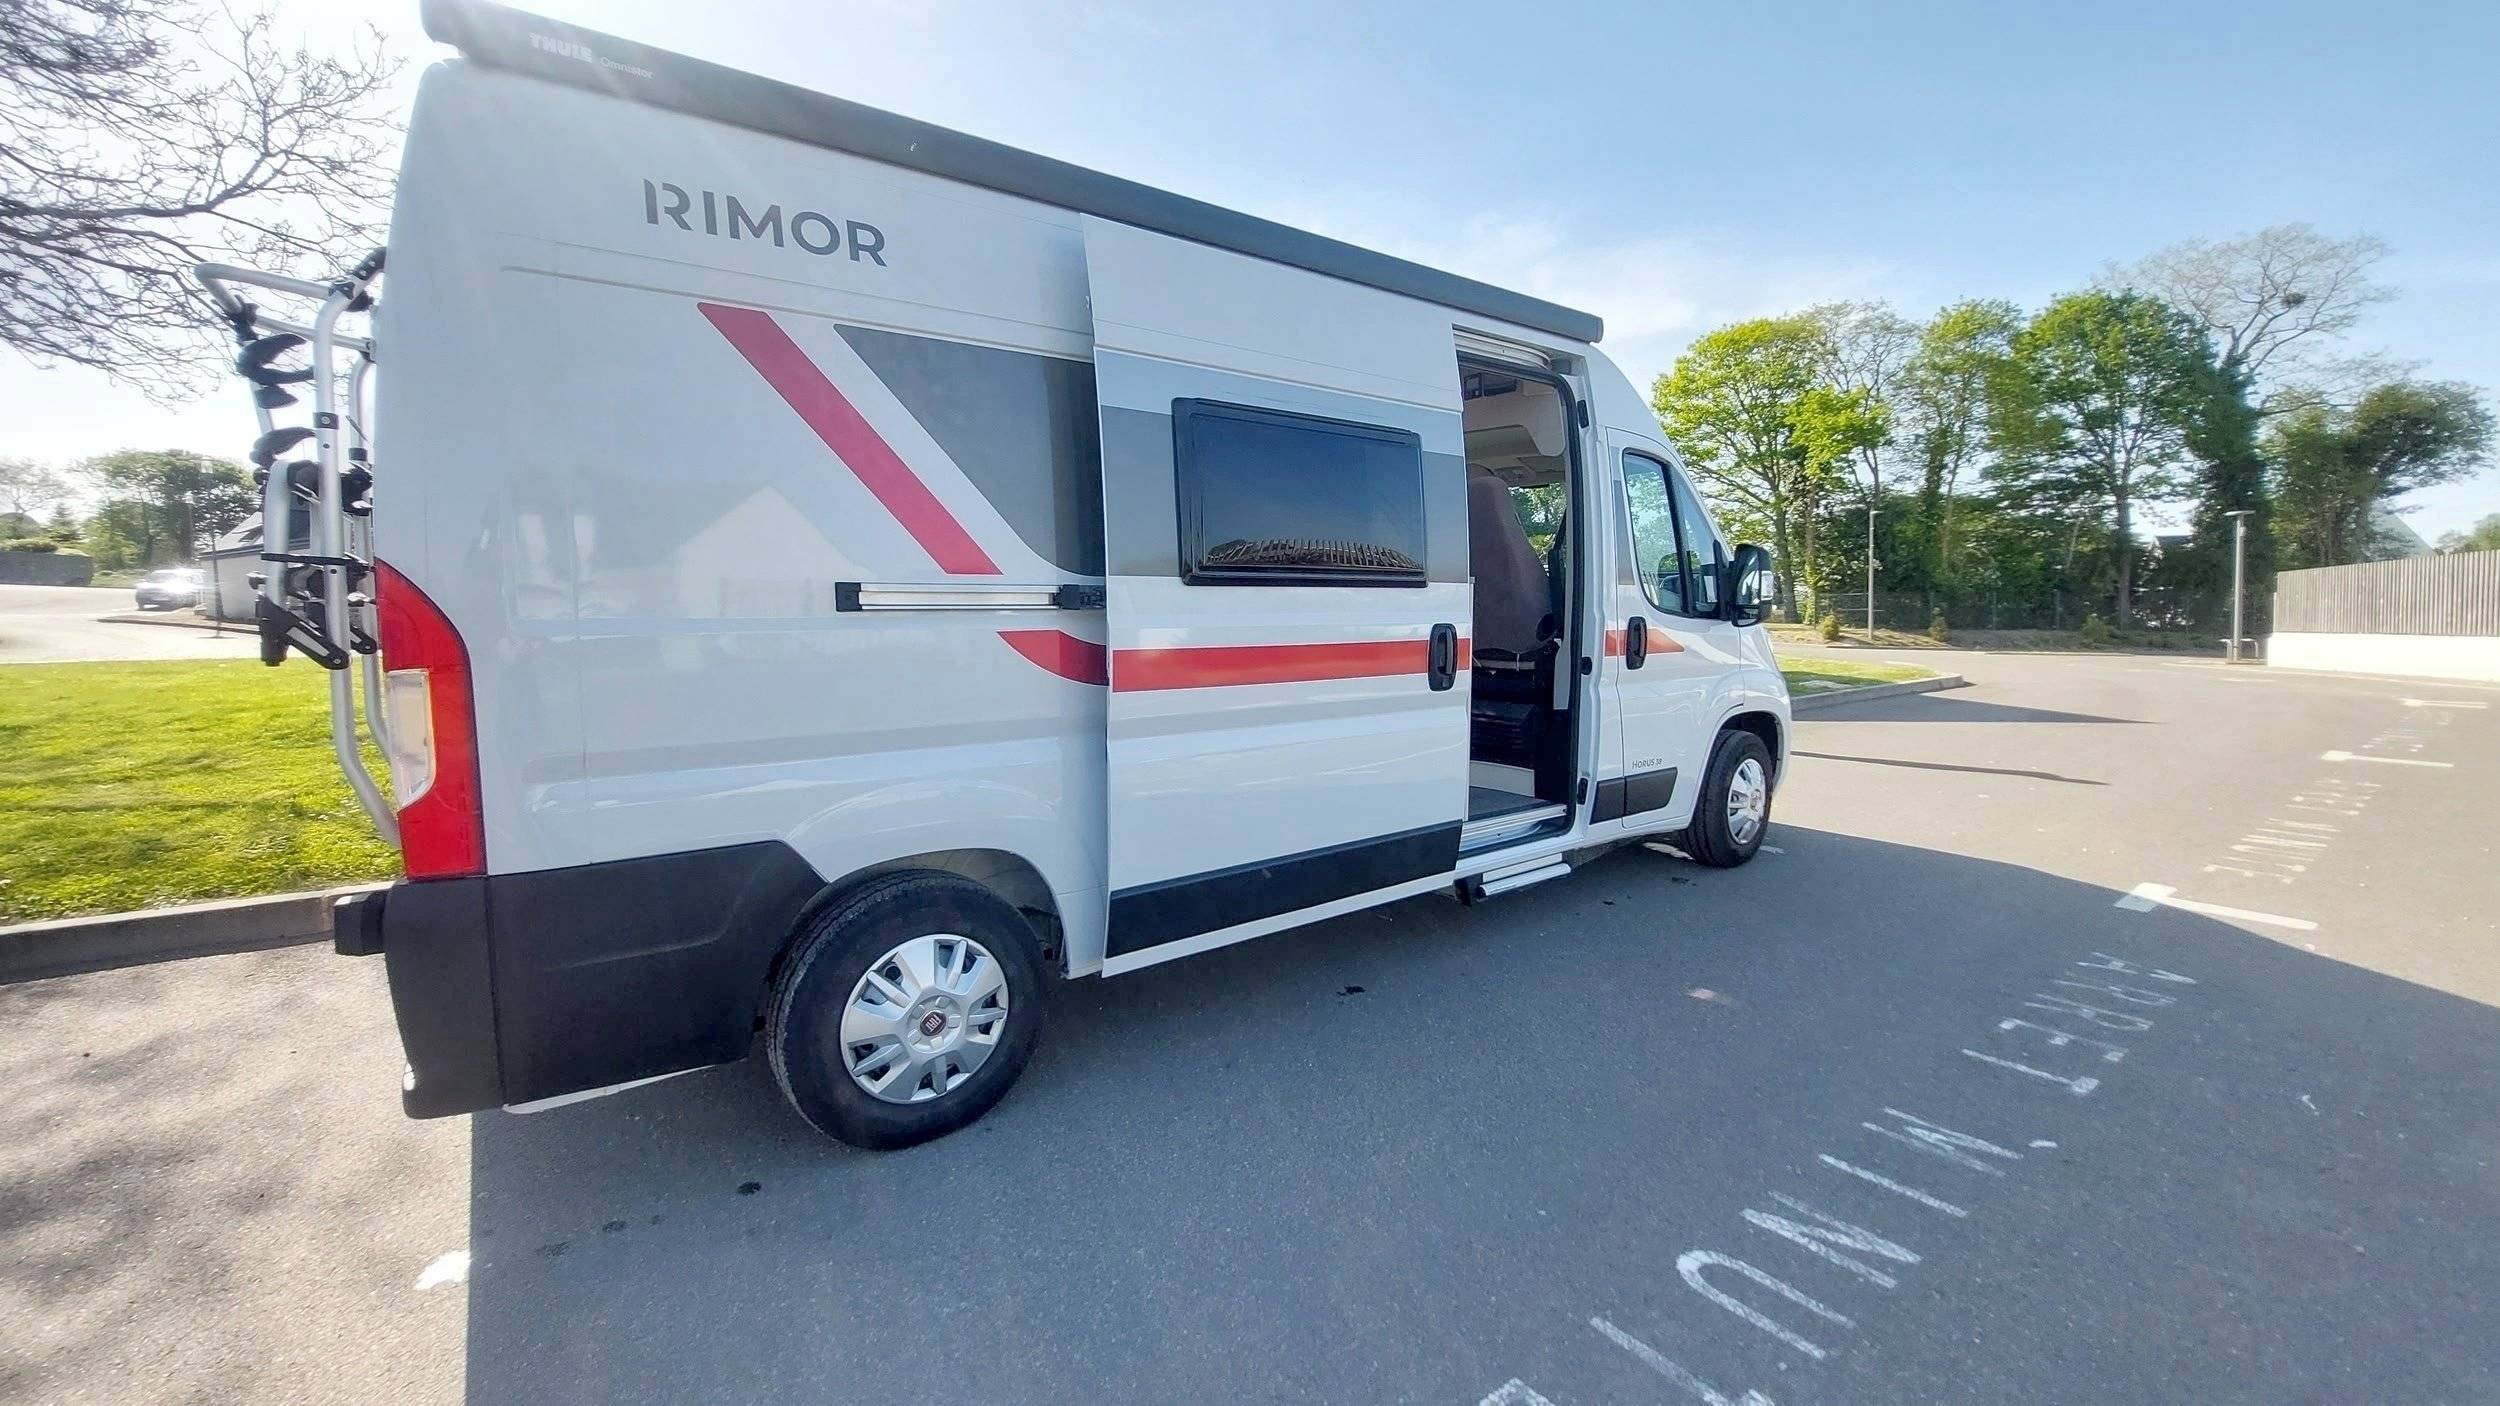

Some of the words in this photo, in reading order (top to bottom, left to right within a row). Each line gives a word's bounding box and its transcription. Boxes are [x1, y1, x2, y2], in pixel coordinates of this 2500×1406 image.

[528, 32, 593, 63] THULE
[600, 56, 655, 79] Omnistor
[643, 179, 888, 267] RIMOR
[1632, 758, 1655, 769] HORUS
[925, 1014, 942, 1032] FIAT
[1478, 1106, 2023, 1405] MINUT
